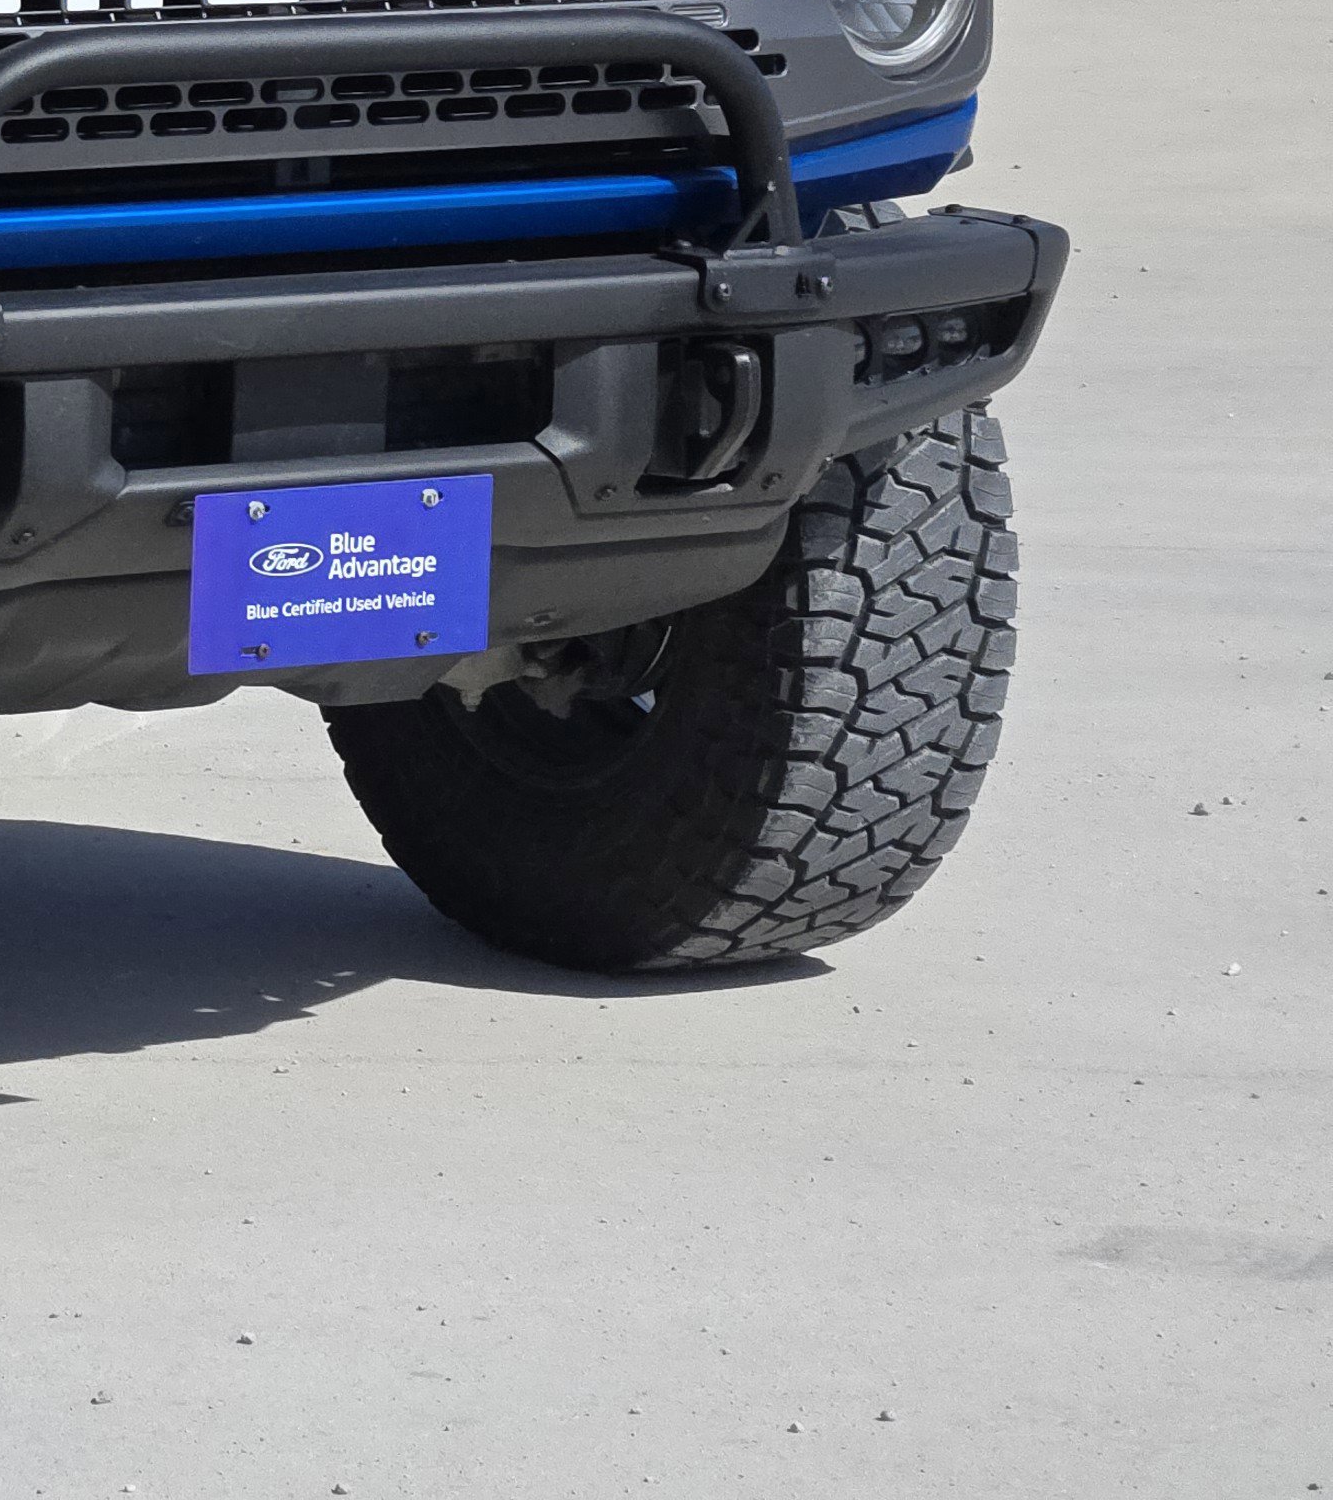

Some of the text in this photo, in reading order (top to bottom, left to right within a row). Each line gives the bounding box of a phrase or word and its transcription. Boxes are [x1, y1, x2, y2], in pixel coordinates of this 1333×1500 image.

[330, 532, 376, 554] Blue
[328, 553, 437, 580] Advantage
[246, 591, 435, 621] Blue Certified Used Vehicle
